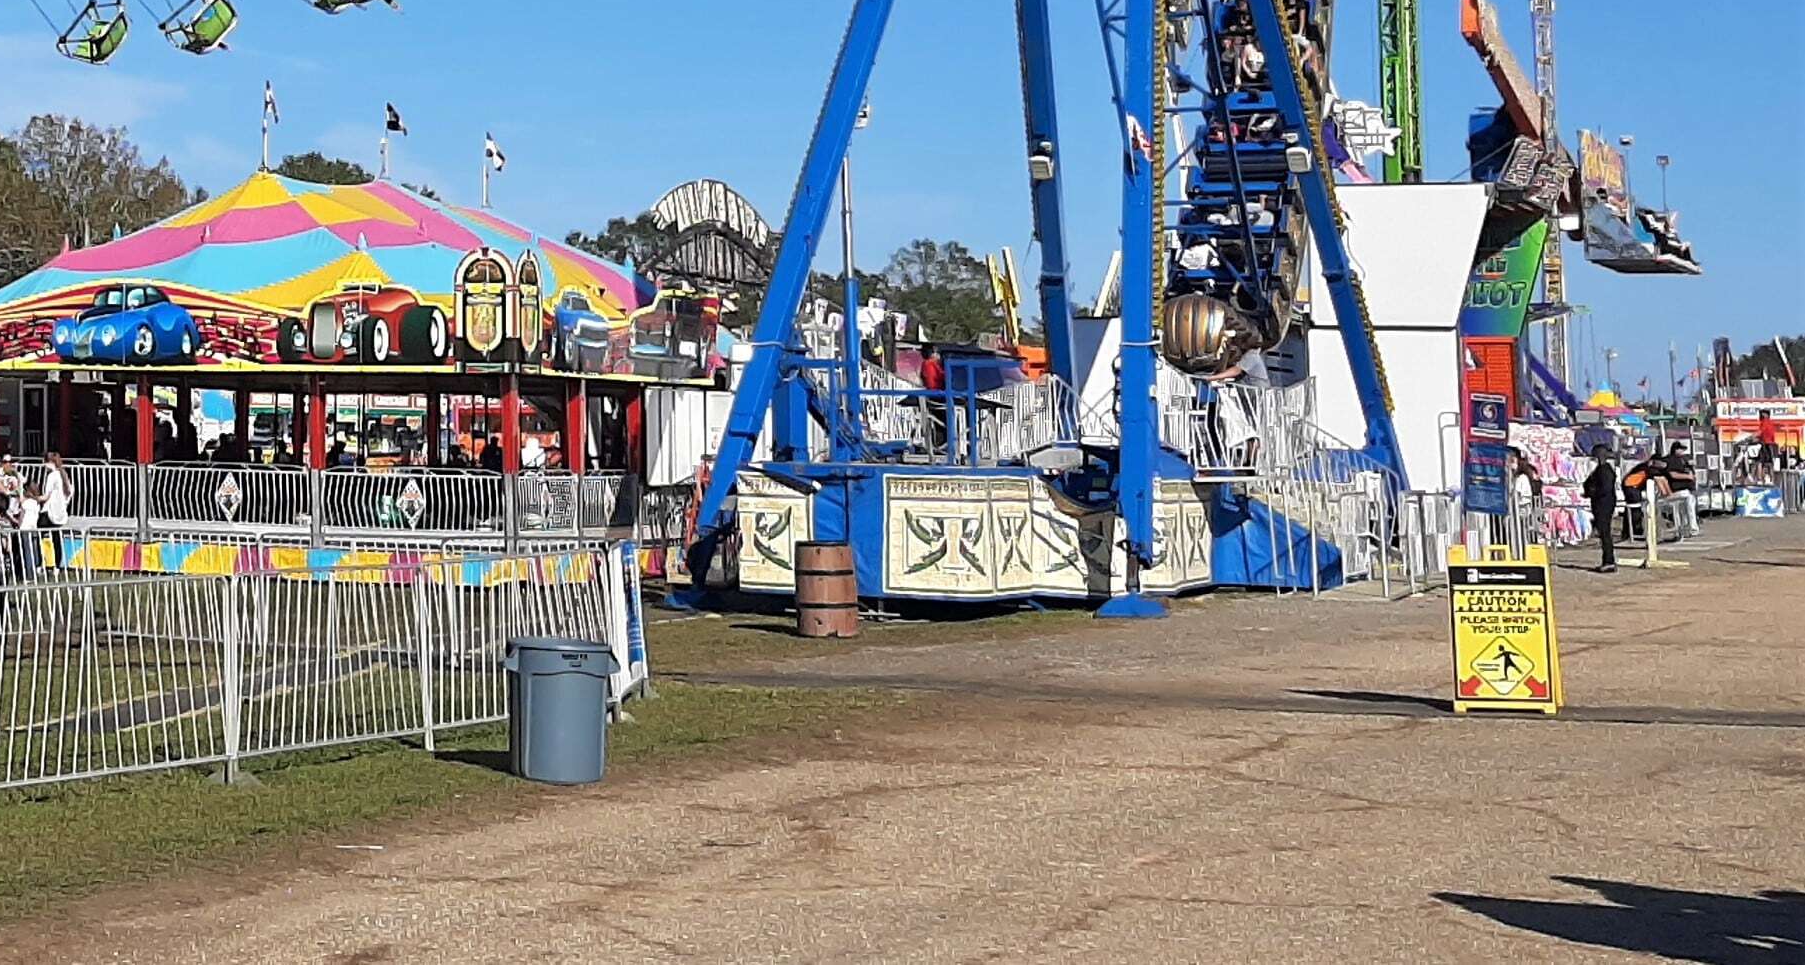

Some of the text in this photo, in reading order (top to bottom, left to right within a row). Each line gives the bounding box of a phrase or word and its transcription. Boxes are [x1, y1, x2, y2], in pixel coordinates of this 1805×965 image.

[1467, 596, 1527, 606] CAUTION
[1460, 615, 1499, 624] PLEASE
[1471, 625, 1530, 634] YOUR STEP
